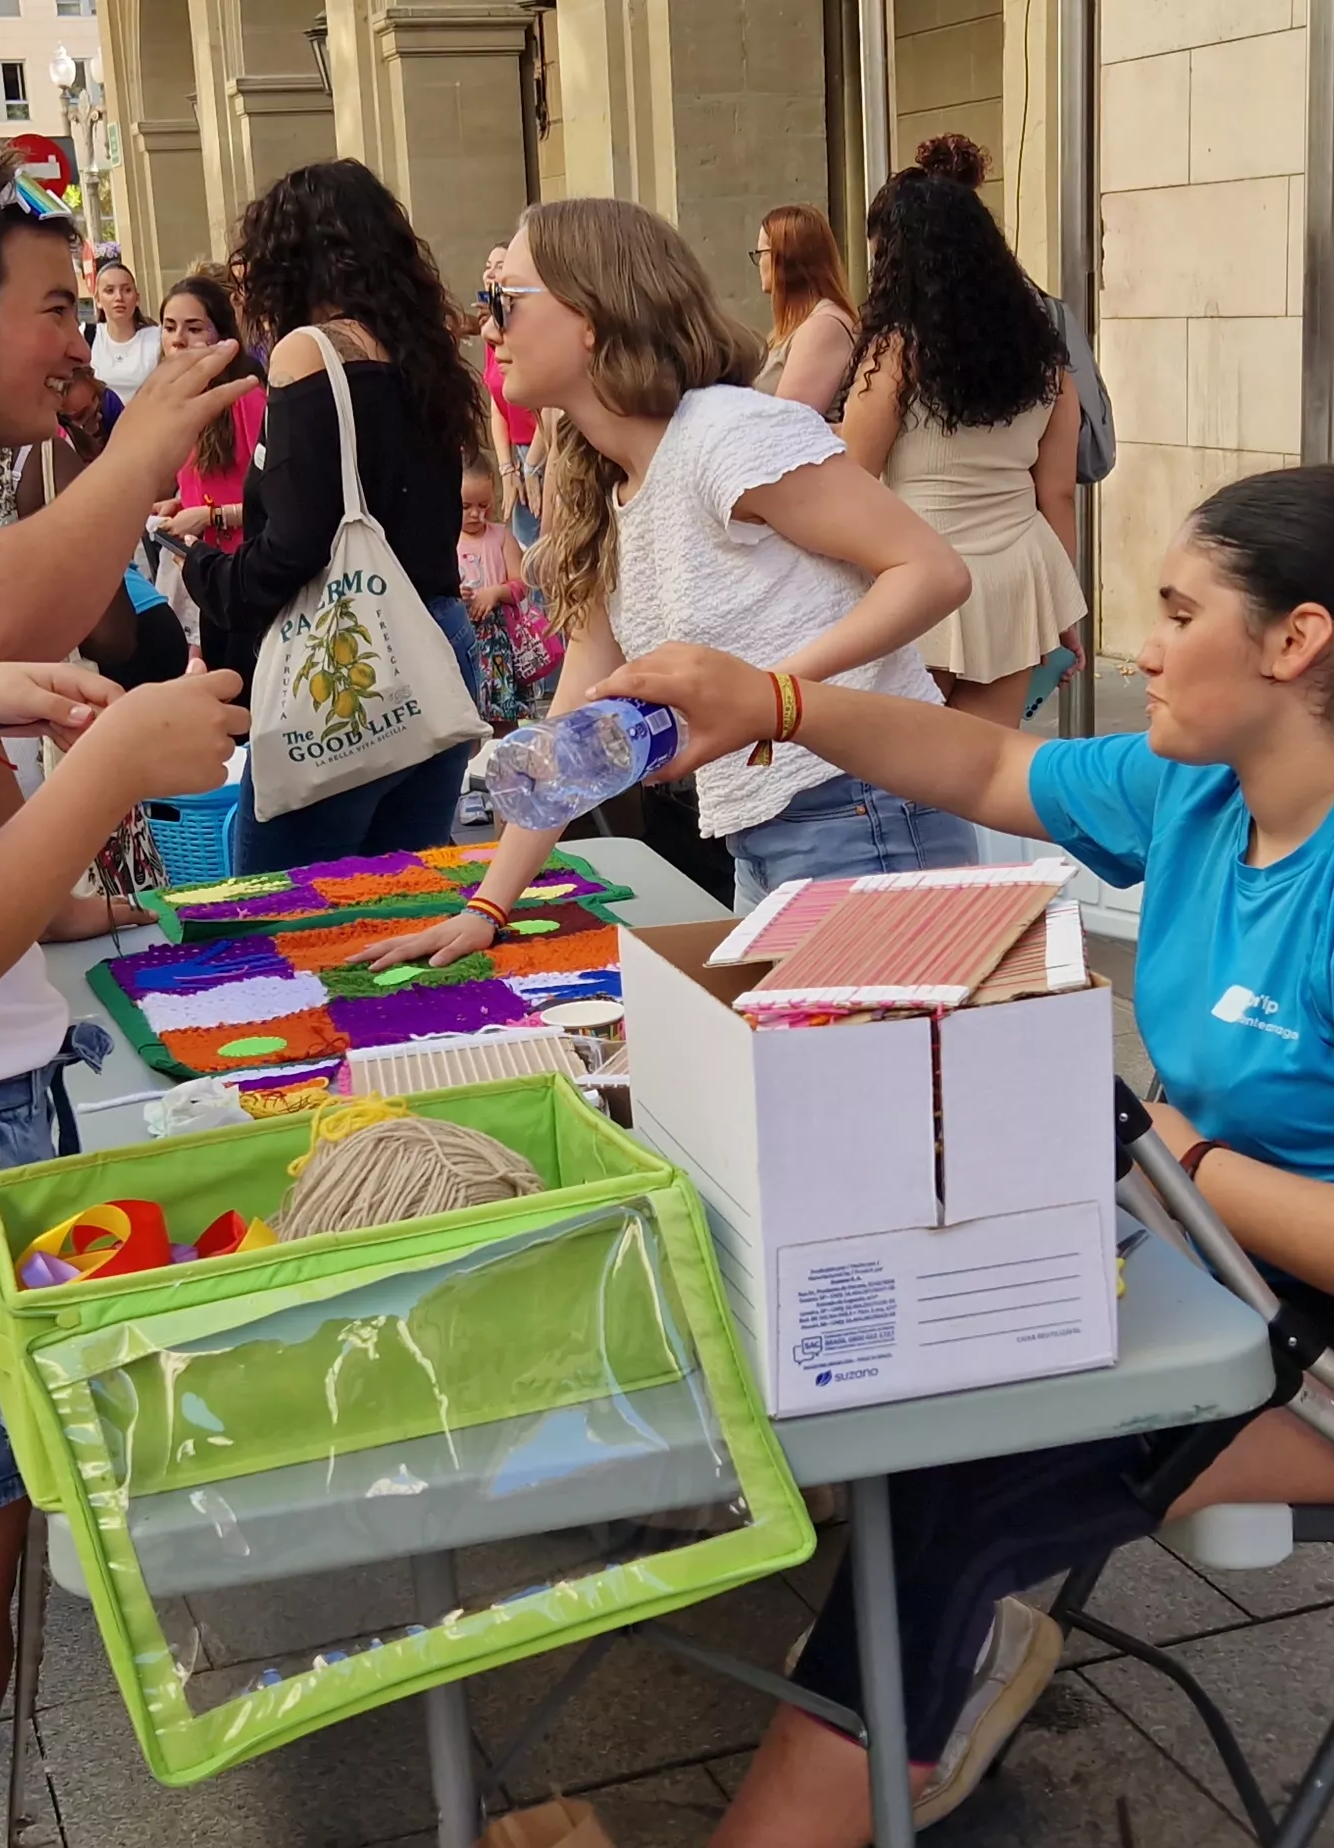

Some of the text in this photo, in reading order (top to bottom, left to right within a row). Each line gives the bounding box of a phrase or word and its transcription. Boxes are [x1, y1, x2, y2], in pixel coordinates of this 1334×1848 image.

[280, 569, 387, 643] PARMO
[375, 609, 400, 676] FRESCA
[280, 654, 291, 720] FRUTTA
[283, 730, 314, 746] The
[288, 699, 422, 763] GOOD LIFE
[328, 750, 354, 764] BELLA
[356, 741, 375, 752] VITA
[377, 725, 407, 742] SICILIA
[804, 1341, 820, 1350] SAC
[834, 1368, 879, 1382] suzano
